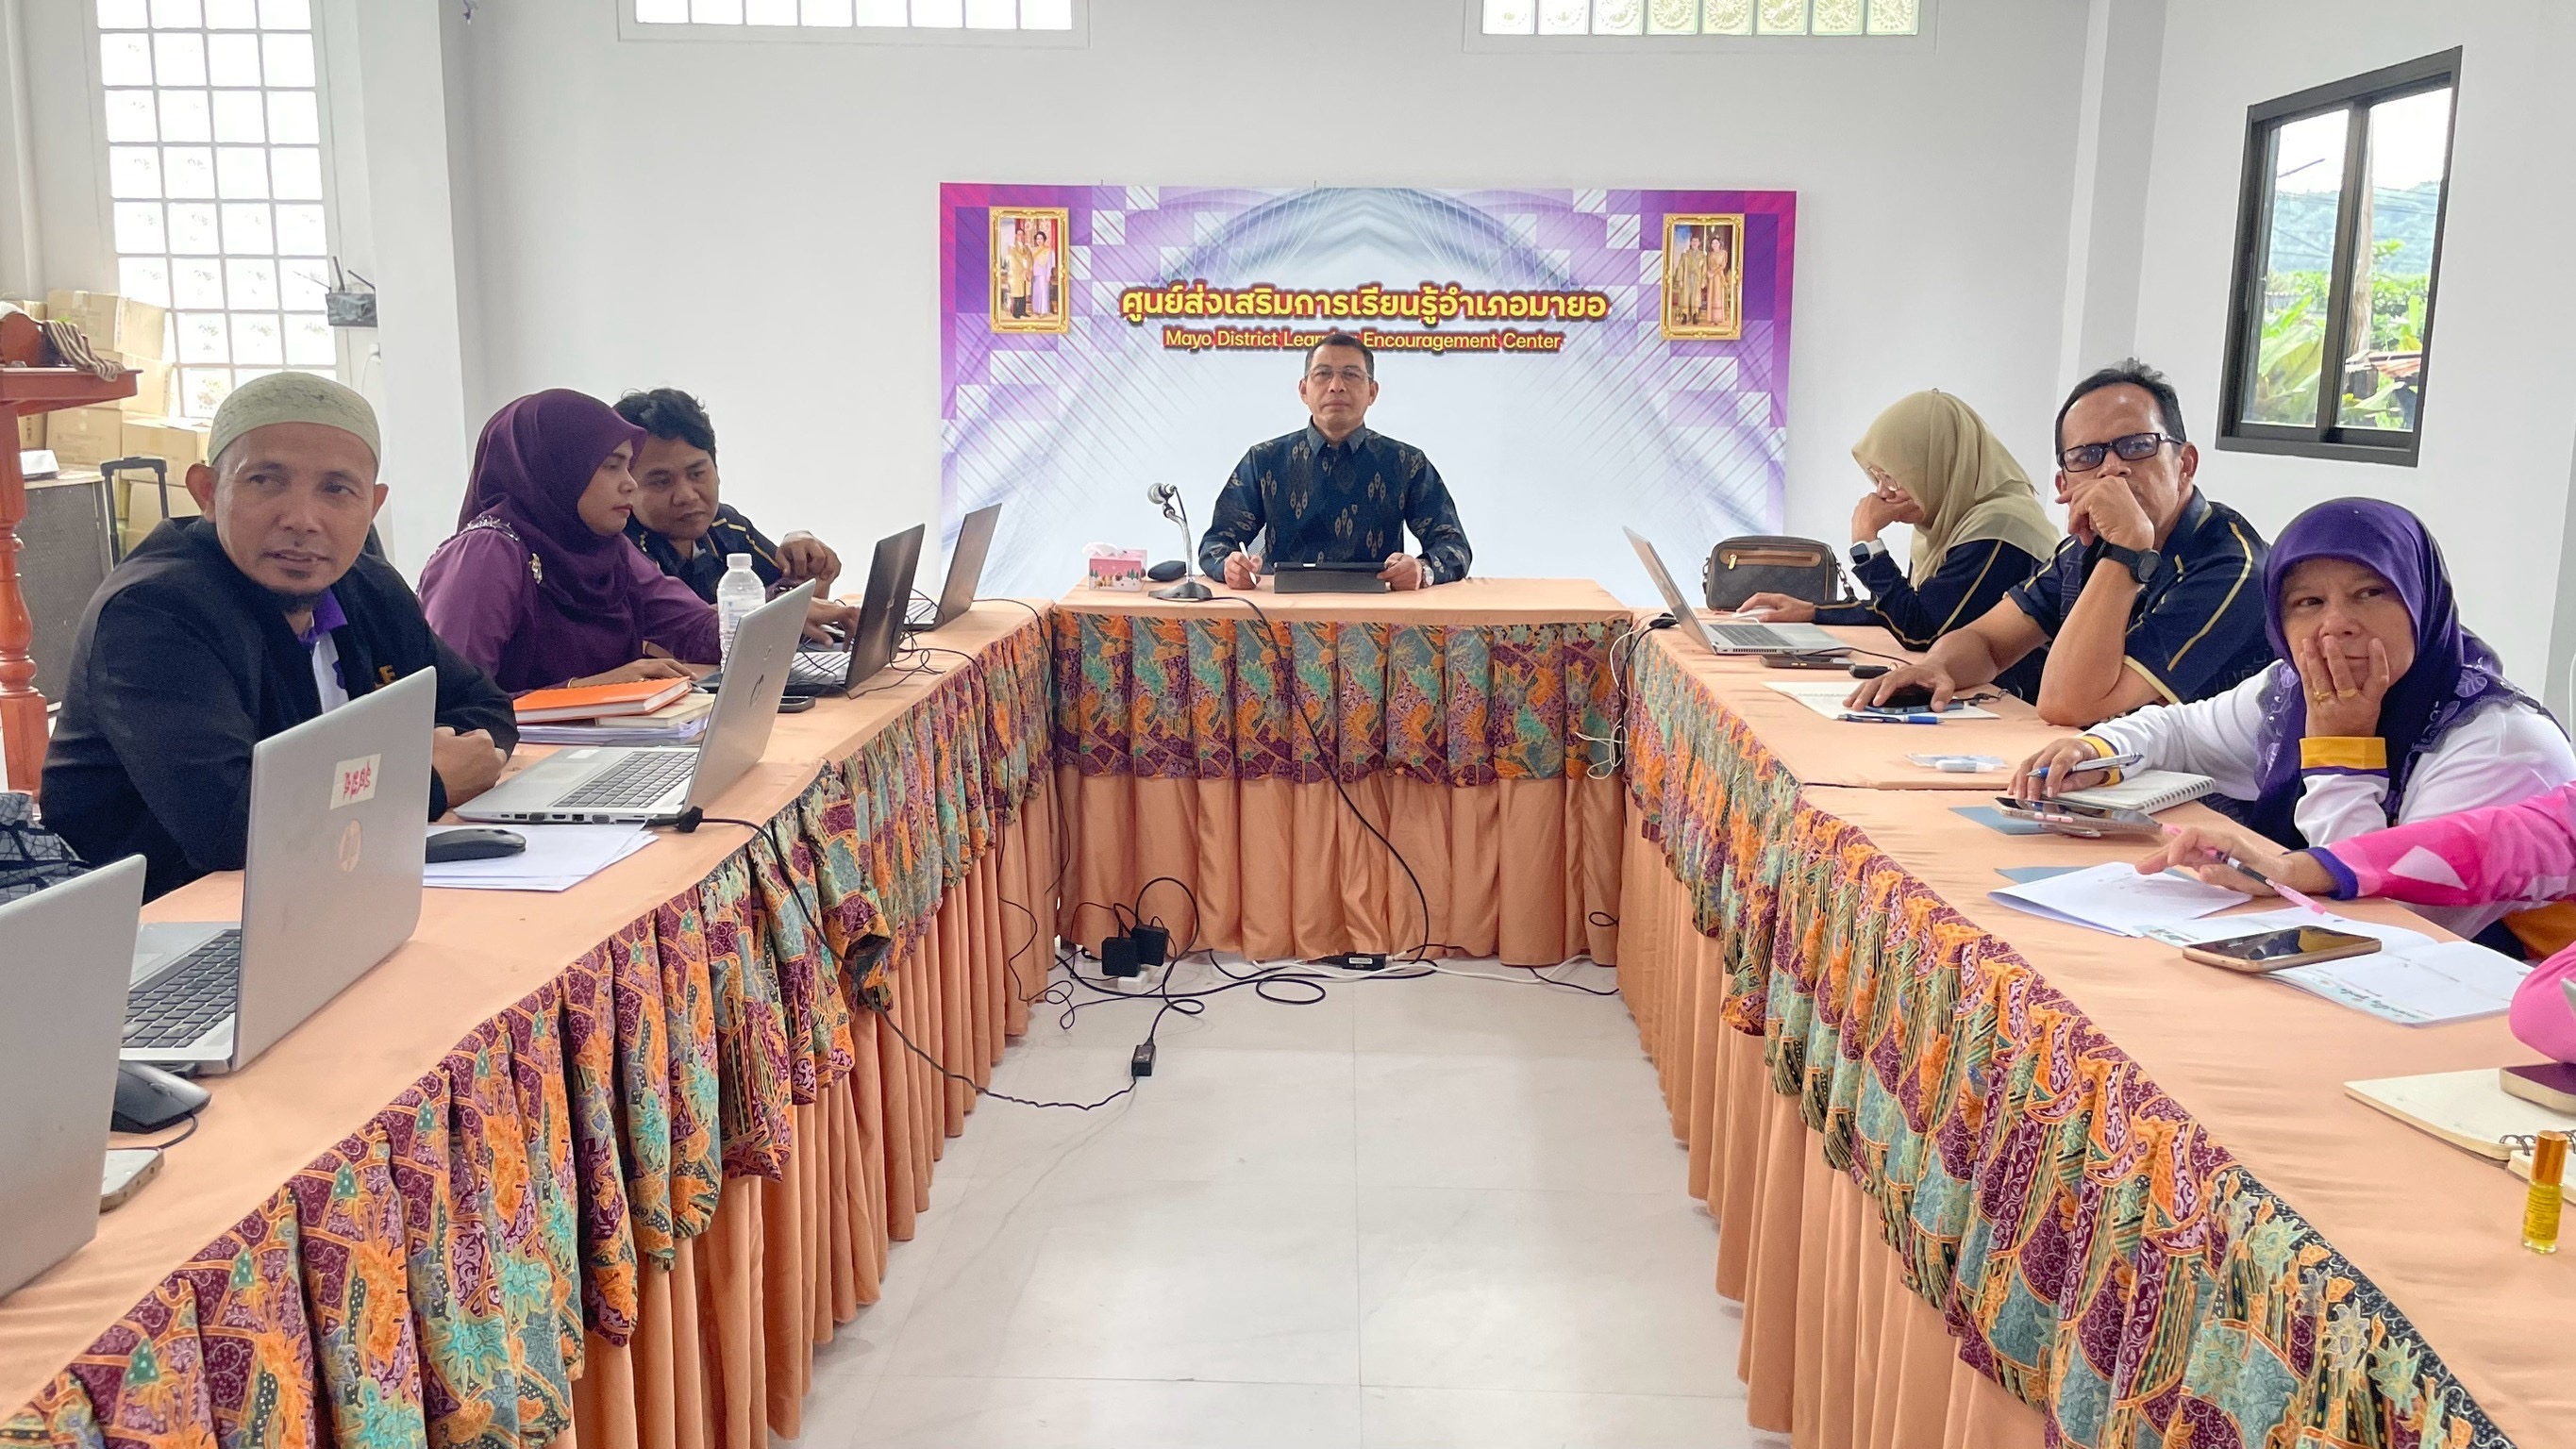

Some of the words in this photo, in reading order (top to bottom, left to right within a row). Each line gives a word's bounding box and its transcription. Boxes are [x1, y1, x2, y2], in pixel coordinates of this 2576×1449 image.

[1121, 283, 1608, 325] ศูนย์ส่งเสริมการเรียนรู้อำเภอมายอ
[1165, 330, 1213, 350] Mayo
[1217, 330, 1279, 347] District
[1363, 331, 1497, 352] Encouragement
[1502, 333, 1562, 349] Center
